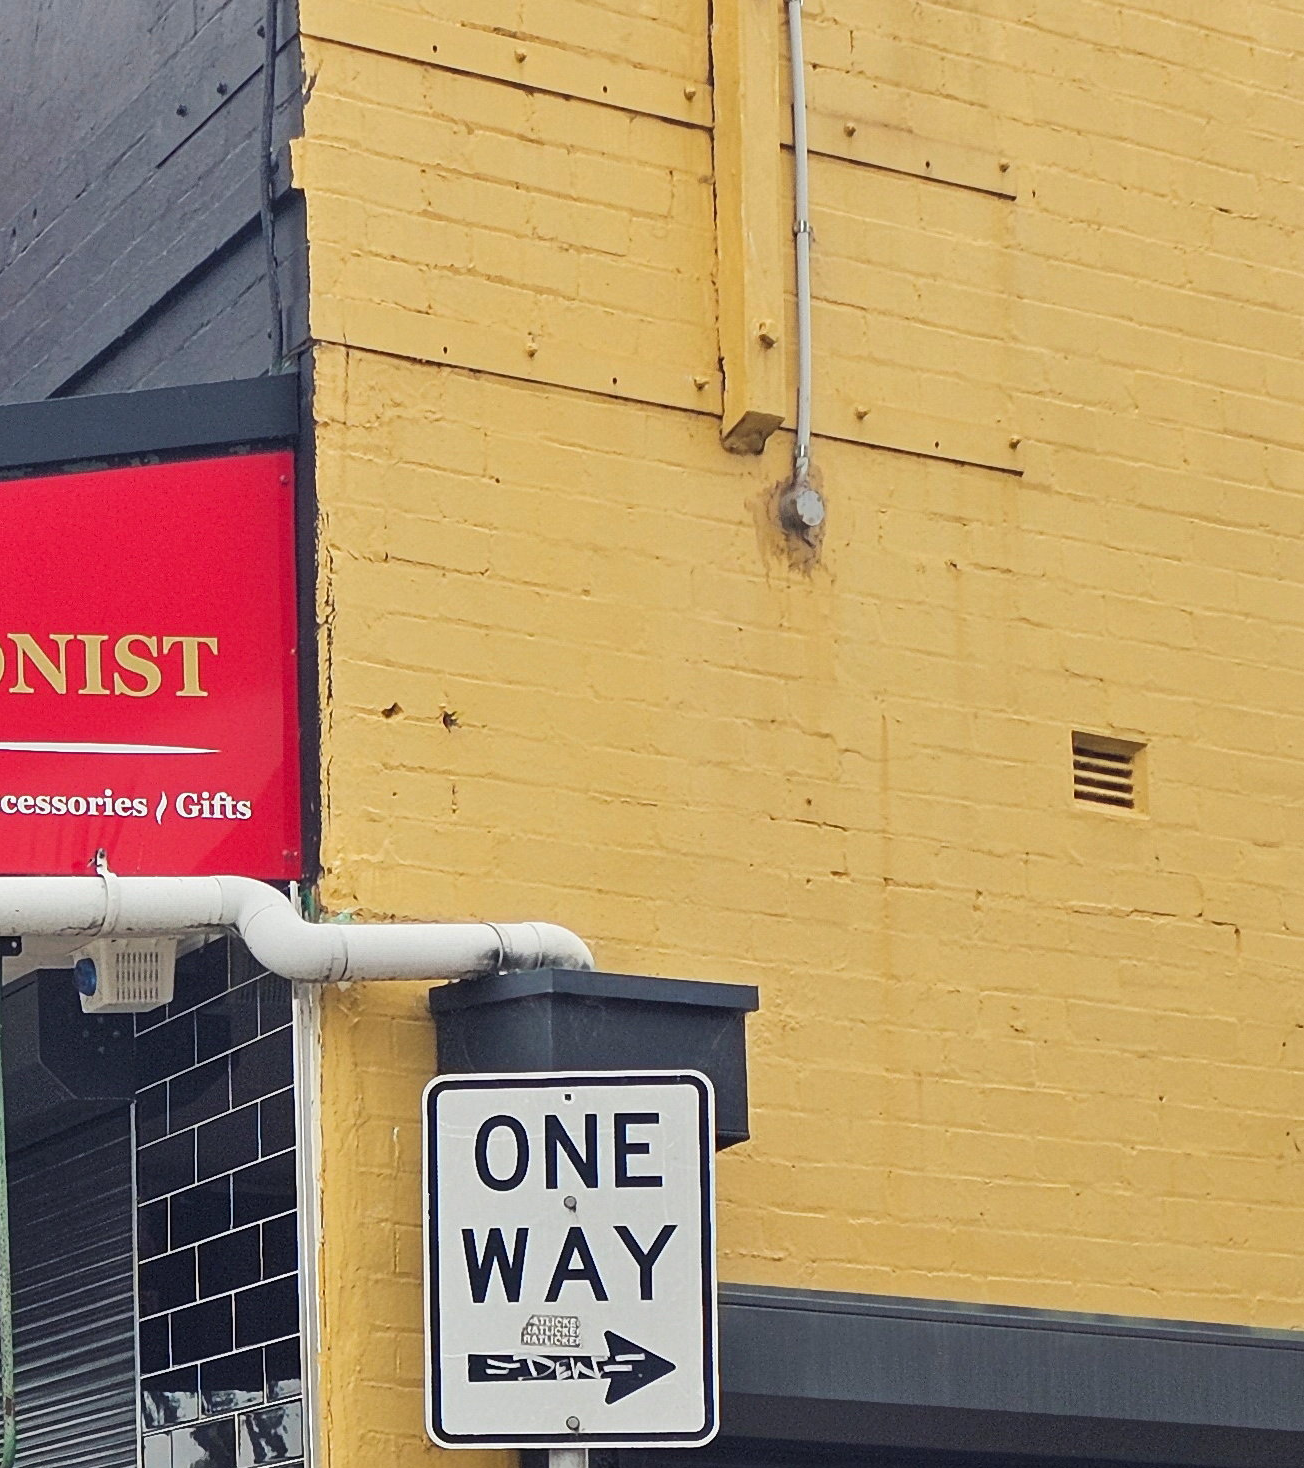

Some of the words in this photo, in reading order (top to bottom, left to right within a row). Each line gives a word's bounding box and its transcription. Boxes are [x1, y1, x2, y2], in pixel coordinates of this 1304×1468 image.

[176, 791, 253, 823] Gifts
[474, 1112, 663, 1191] ONE
[461, 1224, 678, 1304] WAY
